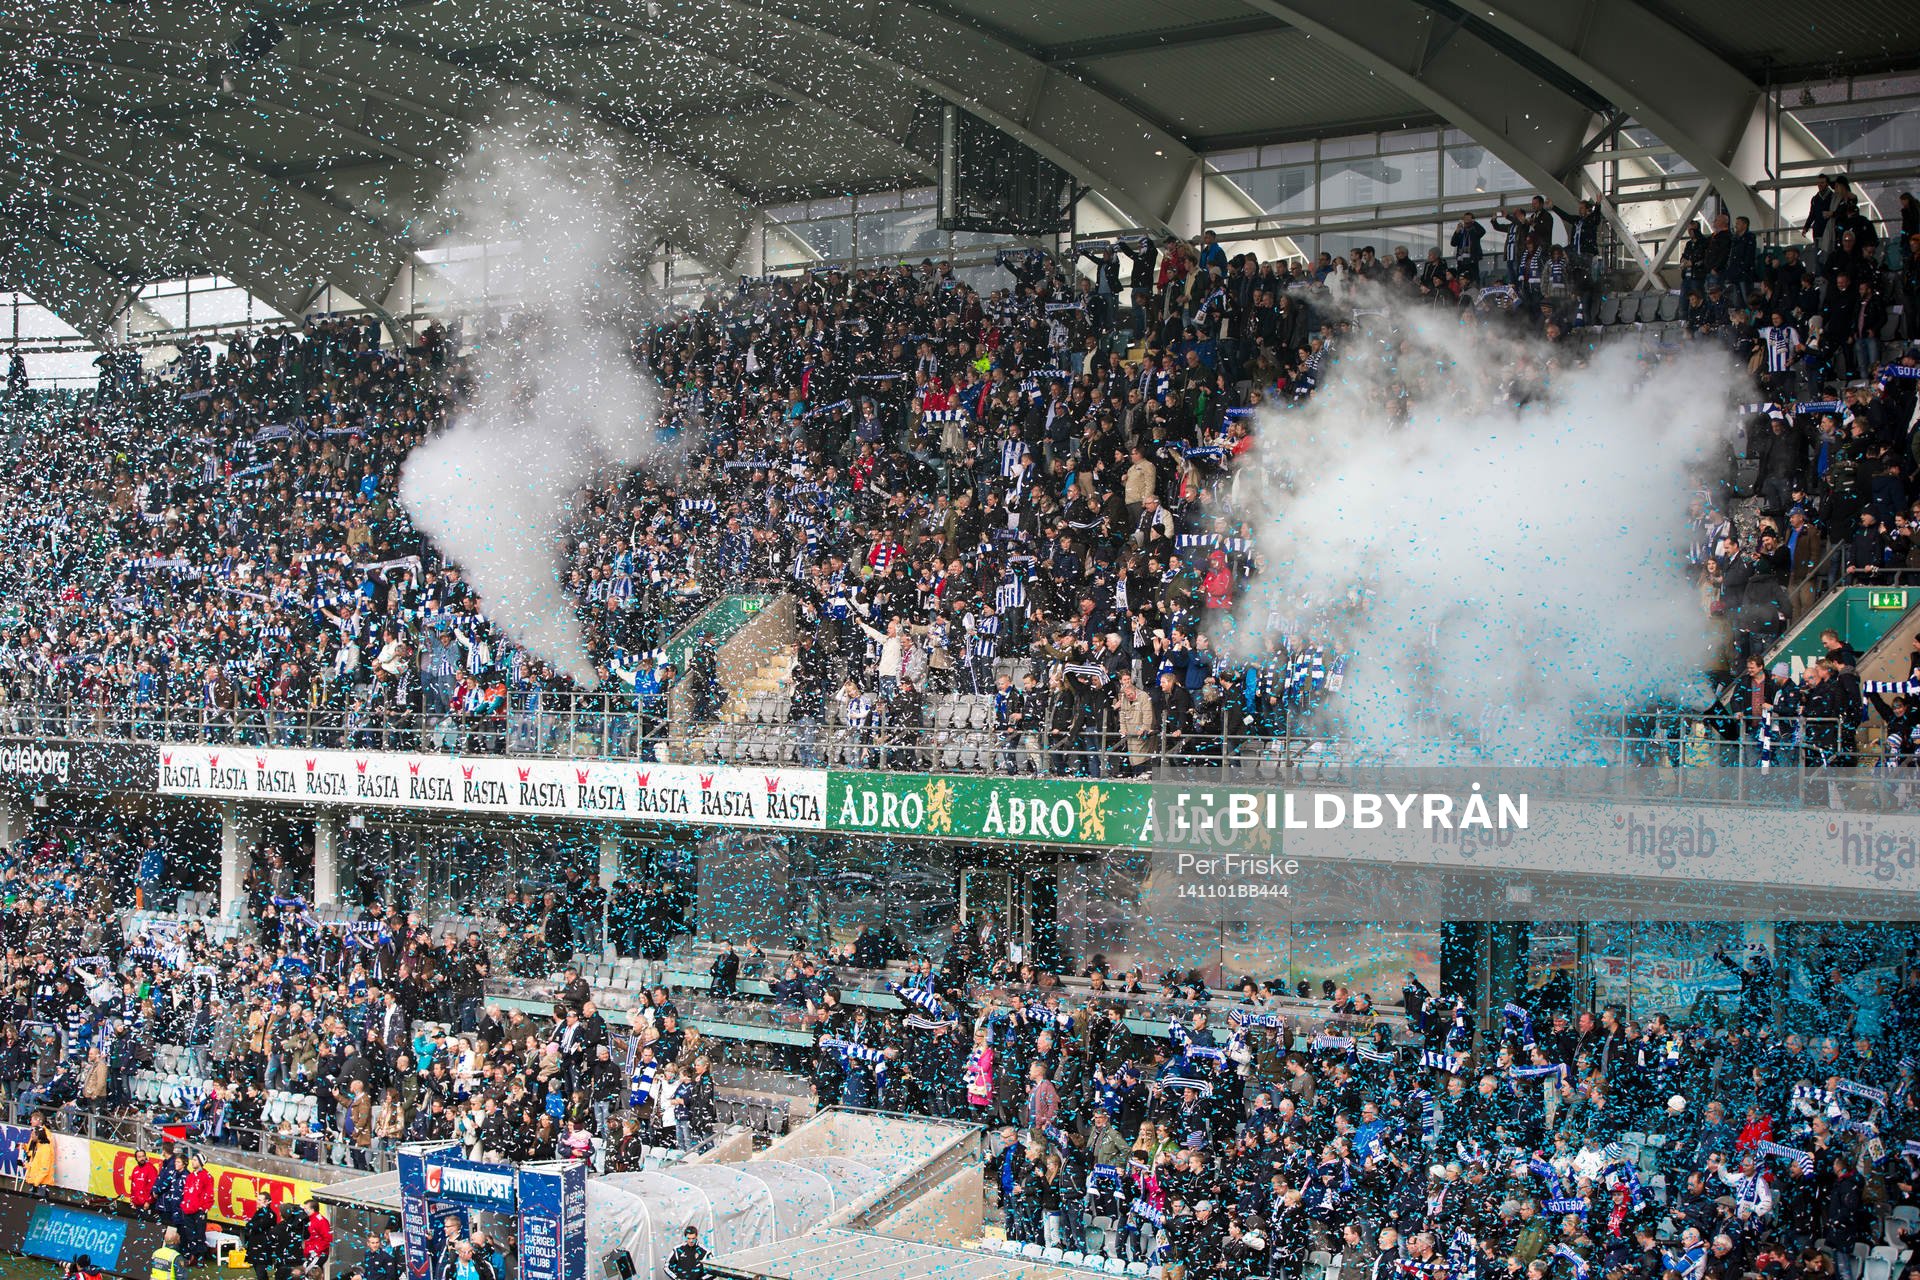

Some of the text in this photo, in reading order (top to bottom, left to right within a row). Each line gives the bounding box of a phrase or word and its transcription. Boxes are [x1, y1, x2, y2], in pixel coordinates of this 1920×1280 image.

[162, 766, 821, 822] RASTA RASTA RASTA RASTA RASTA RASTA RASTA RASTA RASTA RASTA RASTA RASTA
[838, 784, 1239, 847] ÅBRO ÅBRO ÅBRO
[1628, 812, 1717, 870] higab
[1841, 820, 1917, 882] higa
[442, 1174, 512, 1200] STRYKTIPSET
[31, 1218, 118, 1255] EHRENBORG
[524, 1245, 557, 1258] FOTBOLLS
